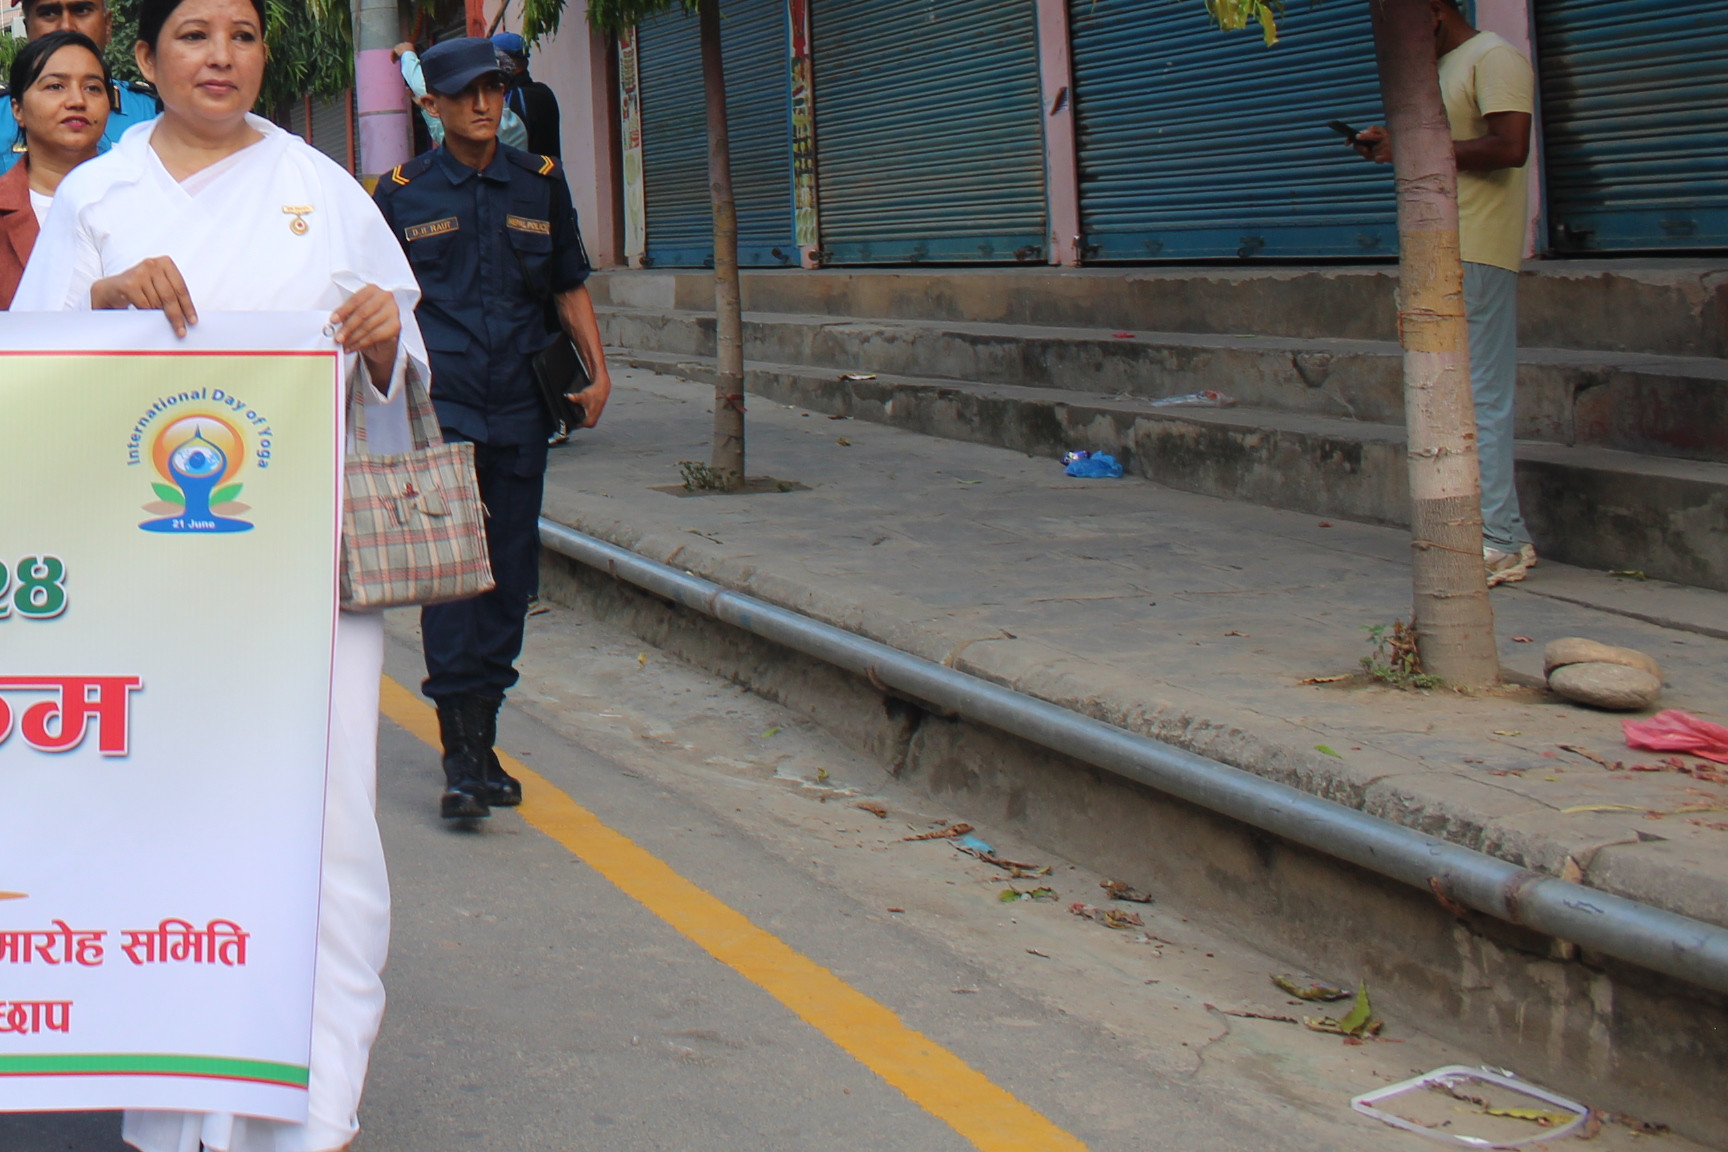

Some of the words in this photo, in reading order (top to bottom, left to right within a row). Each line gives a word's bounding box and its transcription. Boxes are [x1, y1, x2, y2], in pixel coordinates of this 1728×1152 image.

[127, 387, 207, 467] International
[211, 388, 247, 412] Day
[245, 410, 268, 427] of
[257, 426, 273, 469] Yoga
[171, 519, 186, 530] 21
[188, 519, 217, 530] June
[120, 918, 251, 968] समिति
